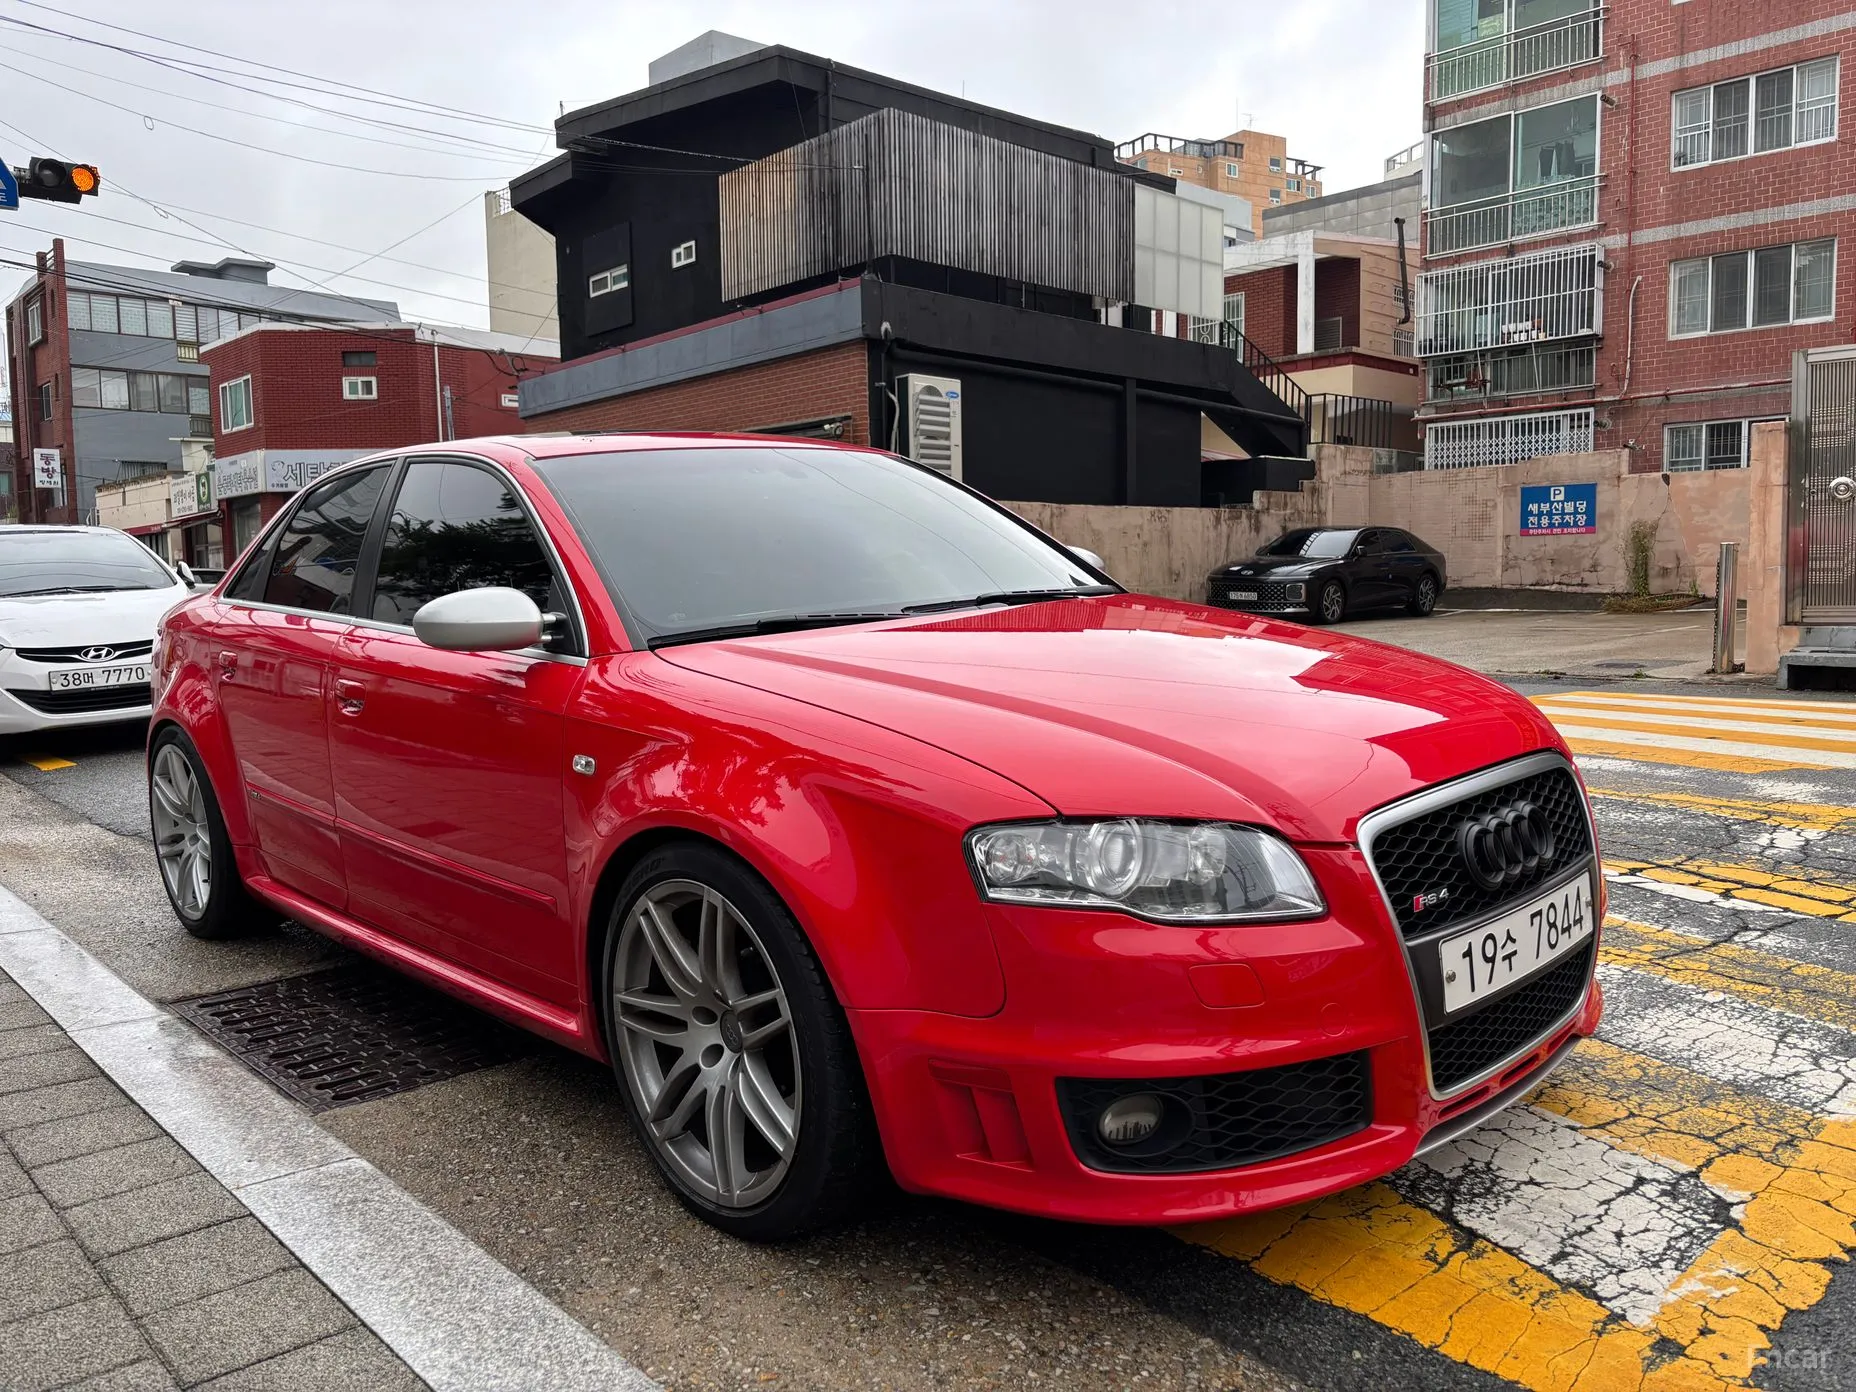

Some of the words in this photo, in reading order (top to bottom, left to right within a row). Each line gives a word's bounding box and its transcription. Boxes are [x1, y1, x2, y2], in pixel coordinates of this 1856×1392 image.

[40, 453, 56, 479] 동방
[1552, 488, 1562, 500] P
[1527, 501, 1587, 514] 새부산빌딩
[1527, 514, 1587, 528] 전용주차장
[60, 672, 94, 688] 38머
[102, 666, 145, 683] 7770
[1461, 927, 1518, 993] 19수
[1530, 885, 1584, 960] 7844
